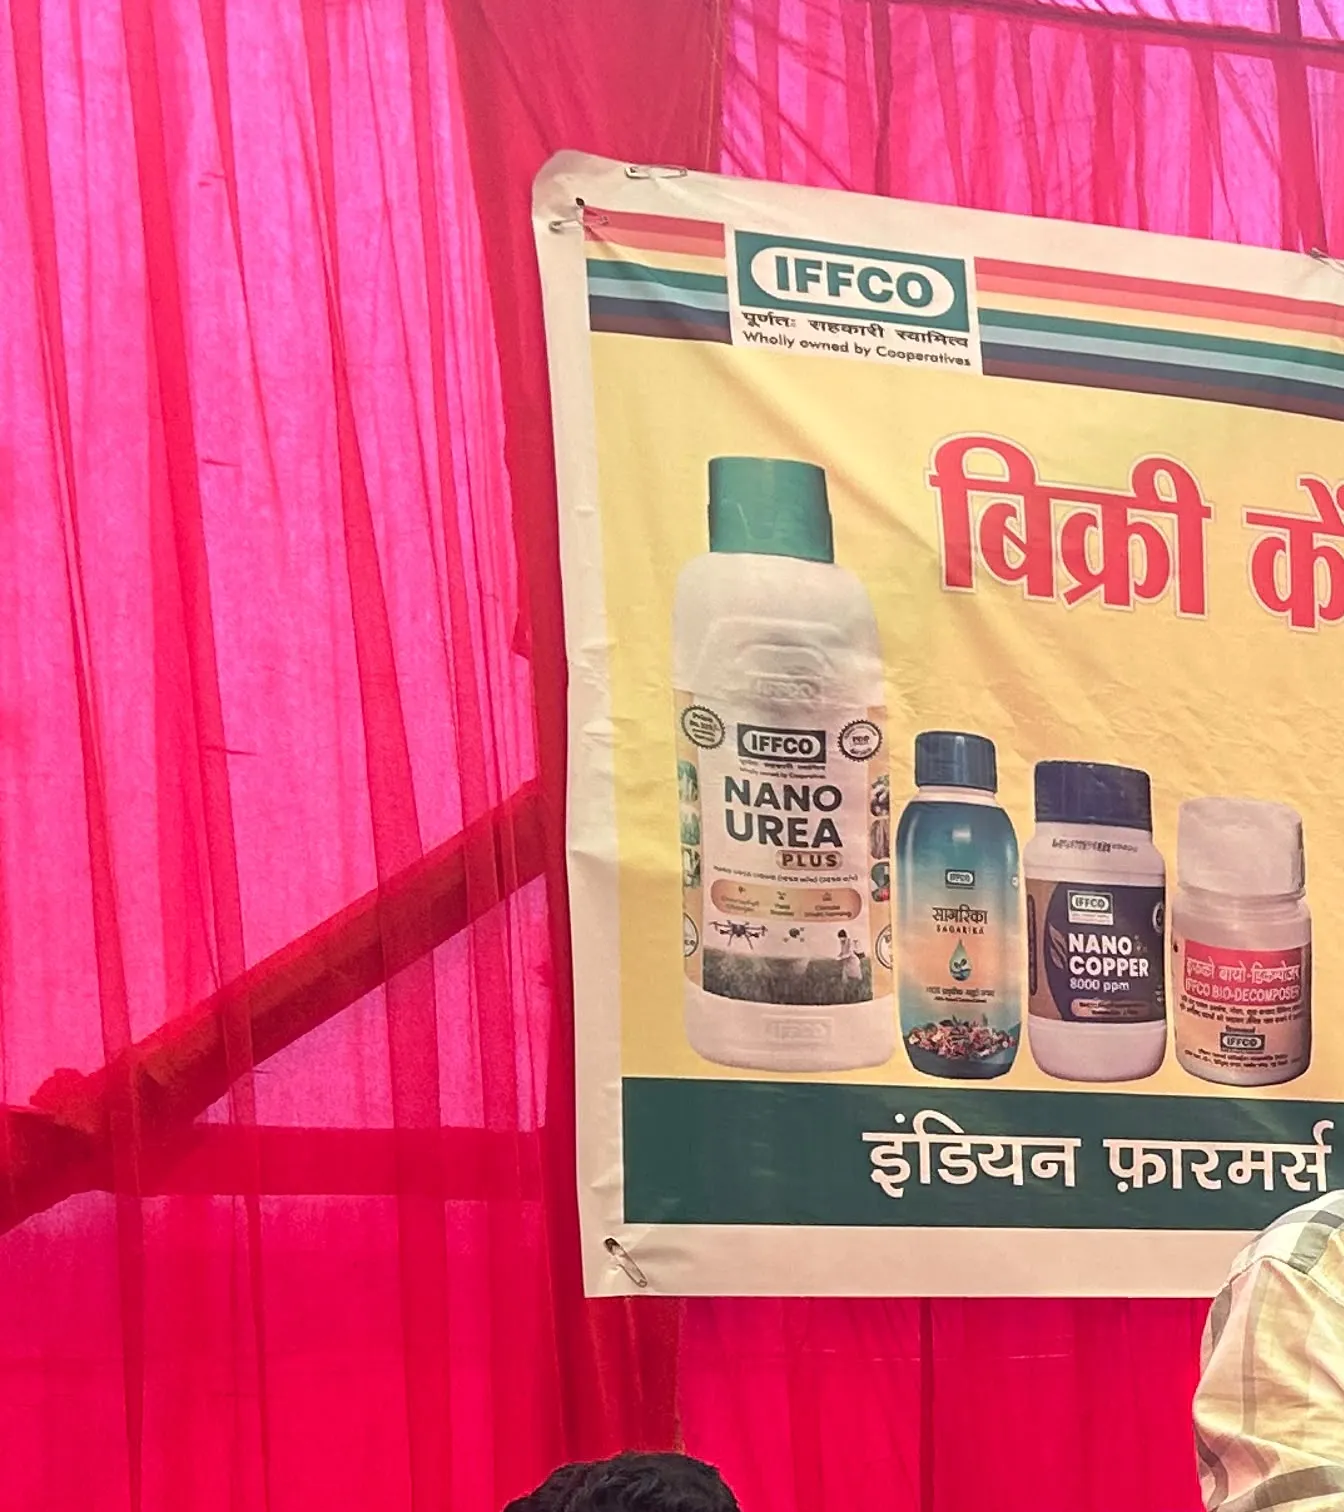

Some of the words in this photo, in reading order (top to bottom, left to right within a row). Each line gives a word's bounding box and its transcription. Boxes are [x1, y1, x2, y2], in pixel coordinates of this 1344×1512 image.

[775, 255, 933, 308] IFFCO
[808, 319, 884, 338] सहकारी
[896, 328, 968, 348] स्वामित्व
[743, 330, 794, 349] Wholly
[800, 338, 849, 353] owned
[855, 342, 871, 356] by
[876, 346, 971, 367] Cooperatives
[929, 435, 1211, 617] बिक्री
[751, 734, 814, 755] IFFCO
[725, 776, 842, 812] NANO
[725, 809, 843, 849] UREA
[782, 854, 838, 867] PLUS
[1075, 897, 1105, 908] IFFCO
[1068, 933, 1132, 956] NANO
[1069, 956, 1149, 977] COPPER
[1070, 977, 1100, 990] 8000
[1103, 981, 1129, 993] ppm
[861, 1108, 1081, 1198] इंडियन
